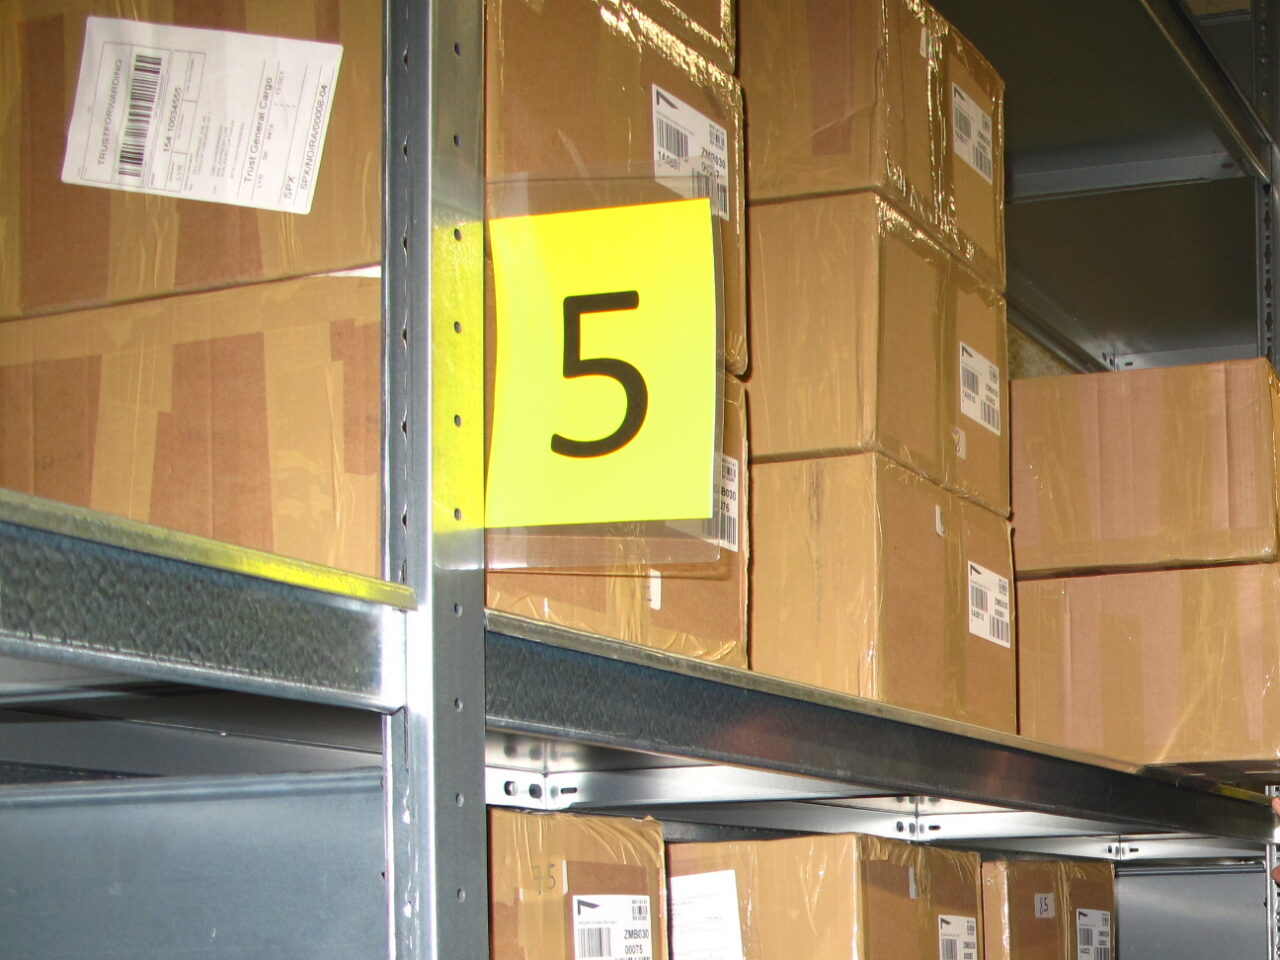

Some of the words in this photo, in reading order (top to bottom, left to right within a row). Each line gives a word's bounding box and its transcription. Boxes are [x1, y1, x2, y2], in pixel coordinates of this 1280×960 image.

[259, 77, 273, 109] Cargo
[97, 58, 122, 165] TRUSTFORWARDING
[163, 136, 172, 153] 154
[250, 112, 266, 154] General
[244, 155, 257, 184] Trust
[284, 175, 297, 199] SPX
[551, 290, 648, 458] 5
